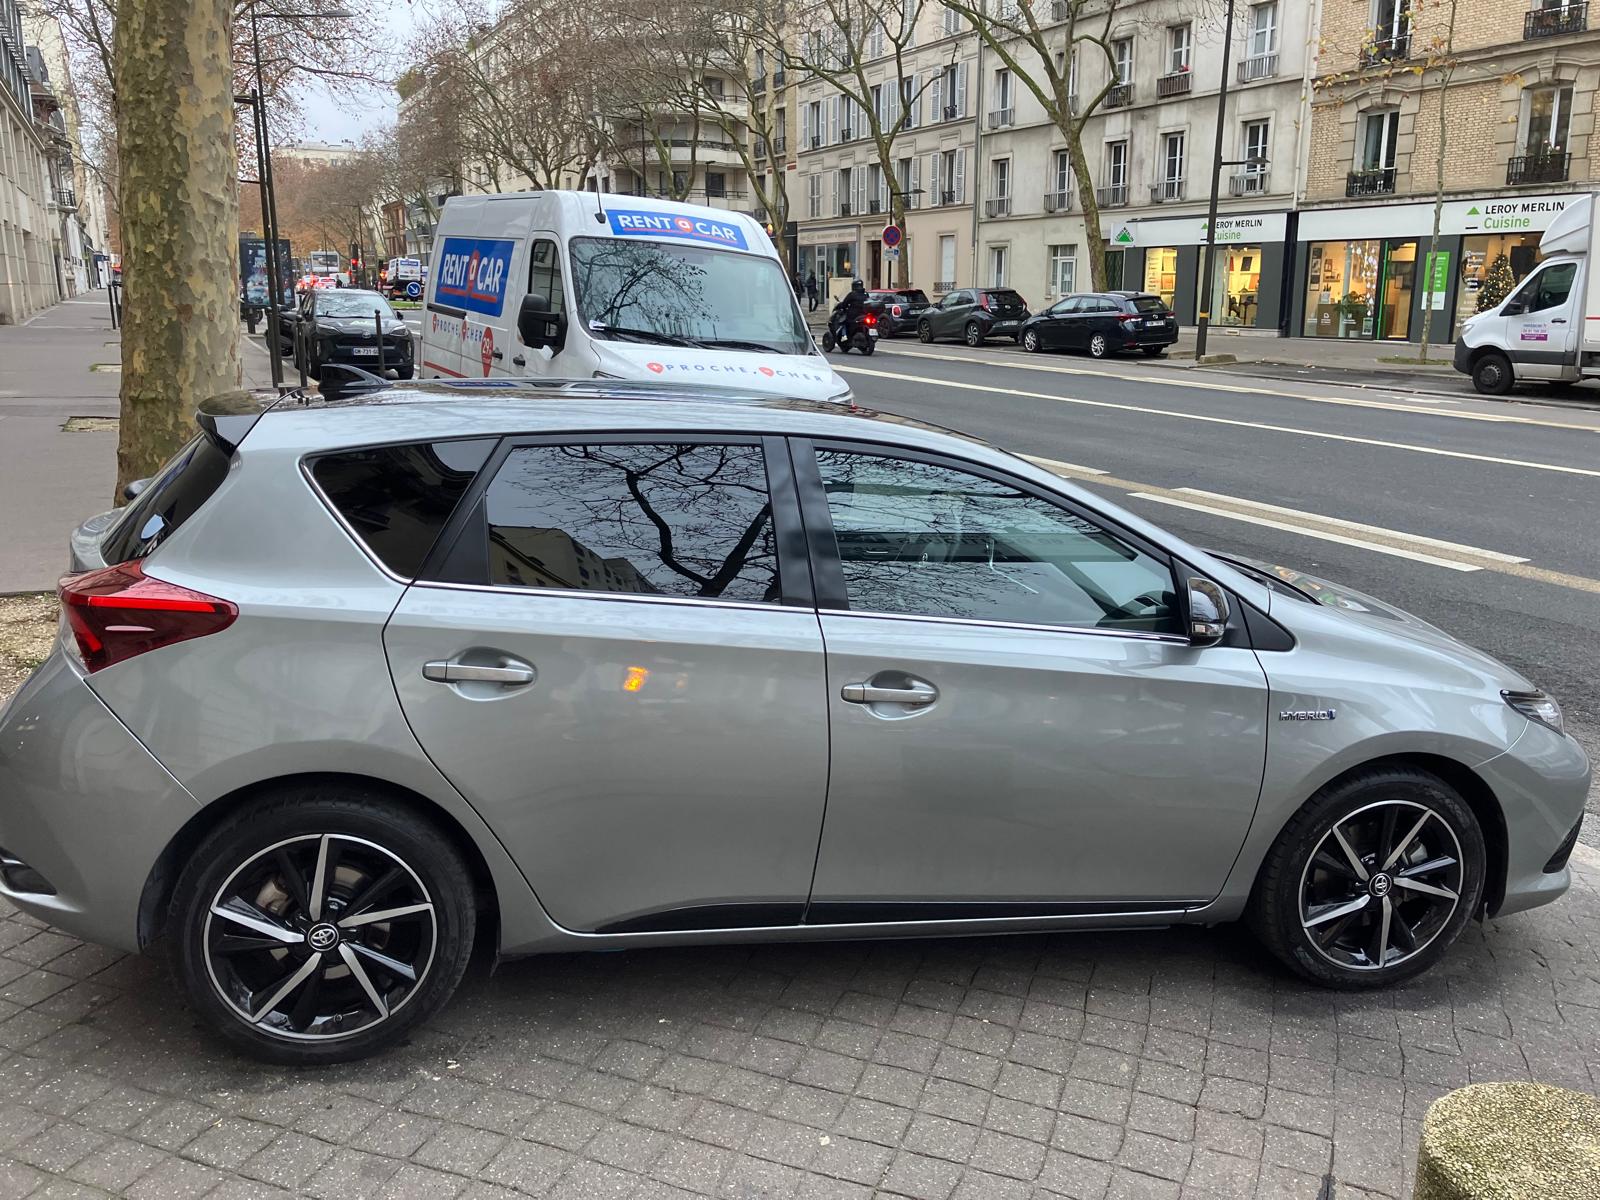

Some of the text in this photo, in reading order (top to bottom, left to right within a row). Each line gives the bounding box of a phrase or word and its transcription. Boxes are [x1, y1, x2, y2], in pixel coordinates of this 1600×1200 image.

[1485, 201, 1565, 215] LEROY MERLIN
[617, 215, 671, 230] RENT
[695, 222, 737, 241] CAR
[1215, 219, 1263, 229] EROY MERLIN
[1484, 215, 1530, 229] Cuisine
[441, 253, 470, 287] RENT
[477, 256, 504, 293] CAR
[775, 370, 824, 383] CHER
[1279, 711, 1329, 721] HYBRID
